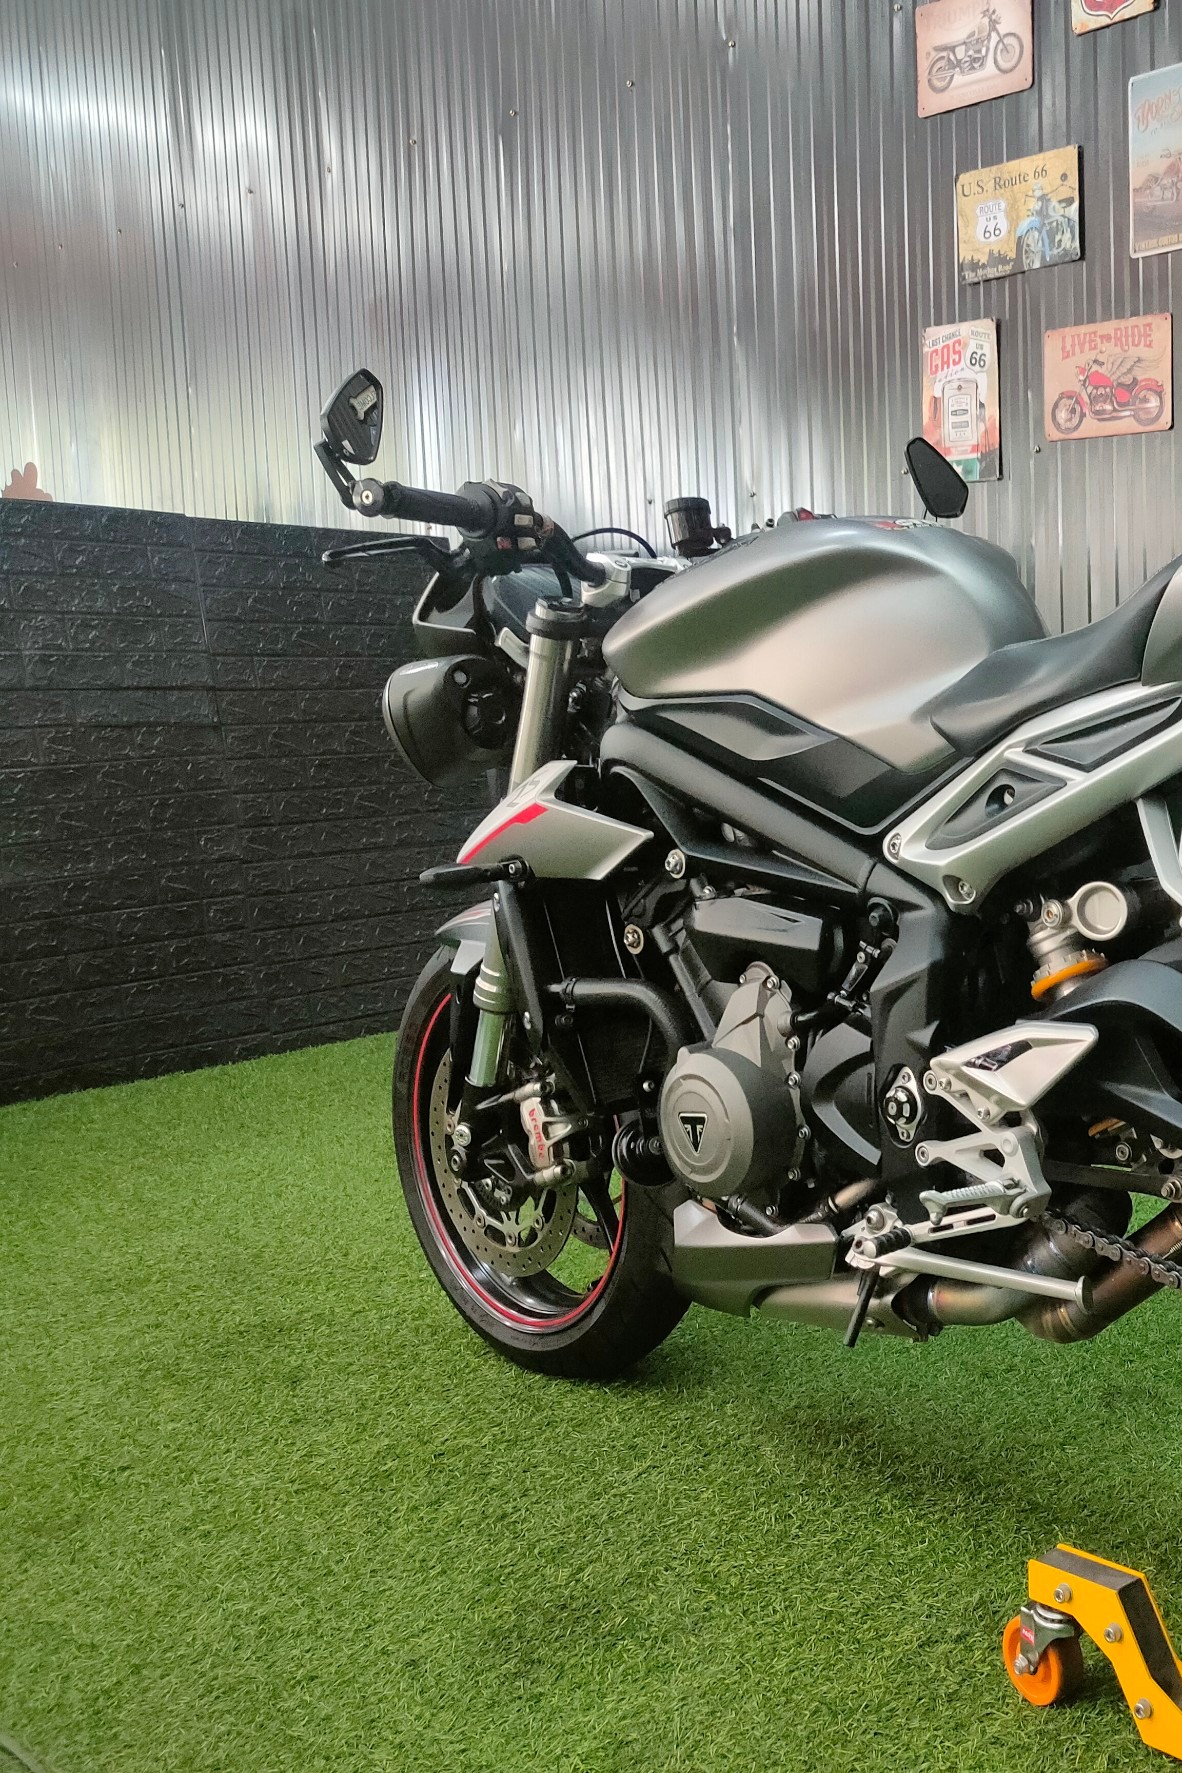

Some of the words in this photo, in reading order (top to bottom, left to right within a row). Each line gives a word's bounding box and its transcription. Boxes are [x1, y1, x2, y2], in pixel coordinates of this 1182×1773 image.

[960, 180, 989, 198] U.S.
[993, 171, 1029, 191] Route
[1033, 164, 1048, 181] 66
[979, 202, 1002, 214] ROUTE
[983, 222, 1002, 239] 66
[928, 336, 941, 349] LAST
[942, 329, 961, 343] CHANCE
[971, 329, 991, 340] ROUTE
[1061, 330, 1098, 361] LIVE
[1114, 322, 1153, 353] RIDE
[930, 337, 962, 377] GAS
[969, 350, 987, 369] 66
